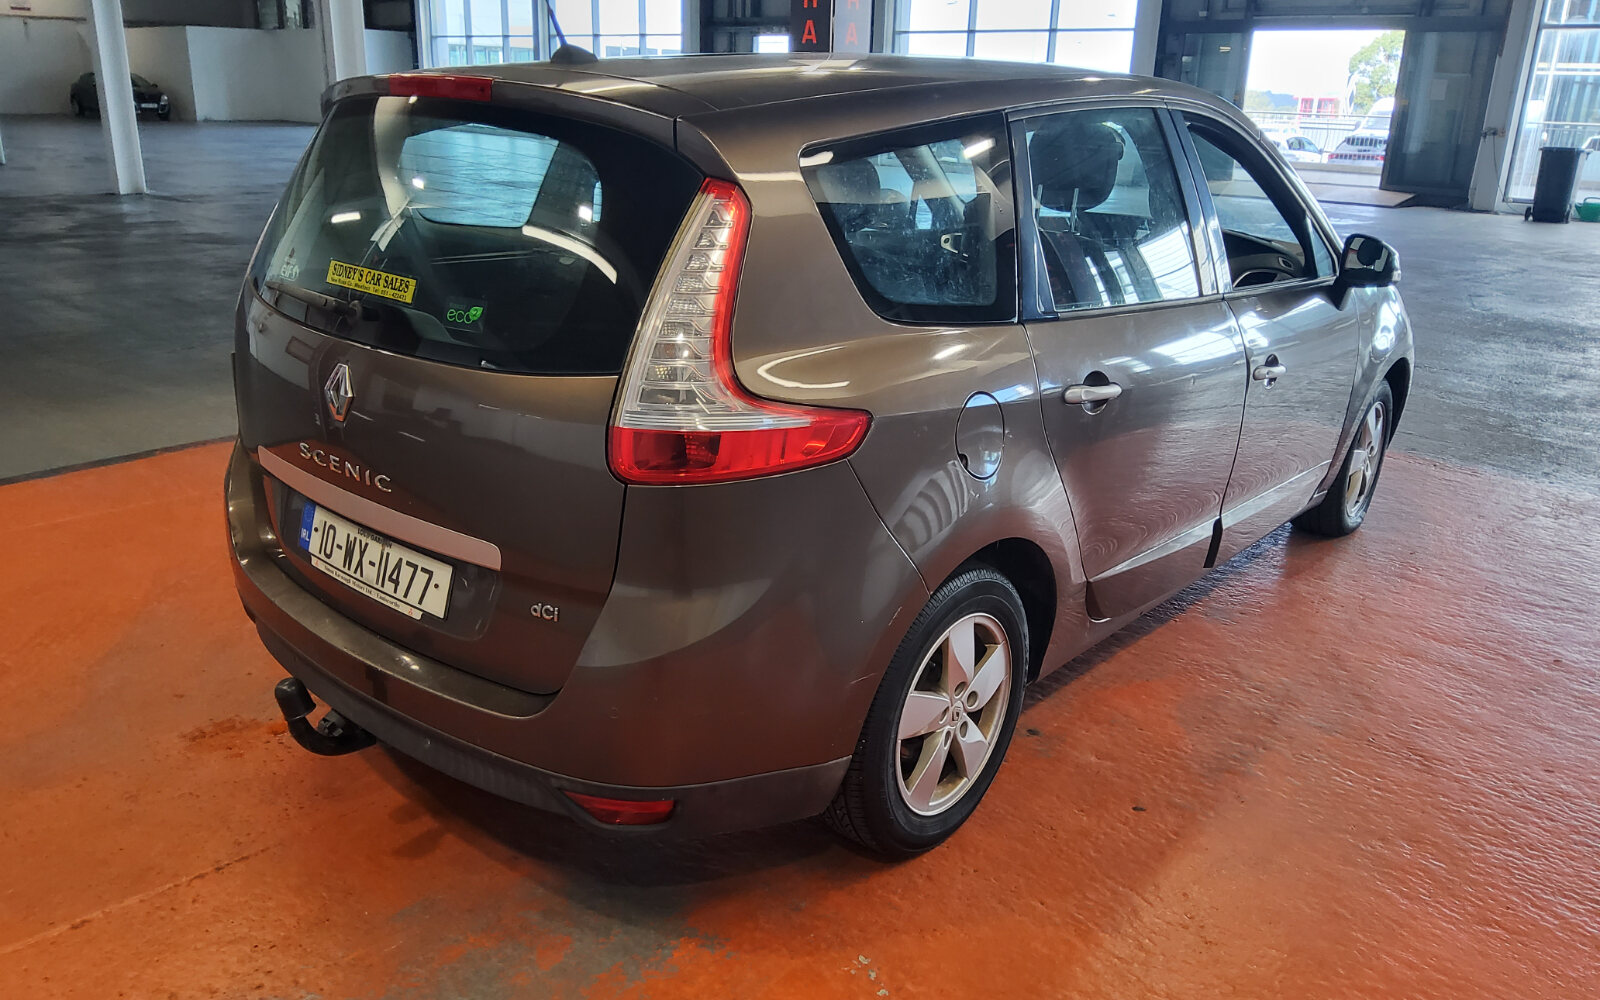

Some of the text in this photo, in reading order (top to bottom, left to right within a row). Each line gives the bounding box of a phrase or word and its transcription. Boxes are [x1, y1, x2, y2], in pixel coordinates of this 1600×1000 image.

[332, 263, 410, 294] SIDNEY'S CAR SALES
[299, 442, 392, 493] SCENIC
[300, 527, 310, 542] IRL
[530, 602, 559, 622] dCi
